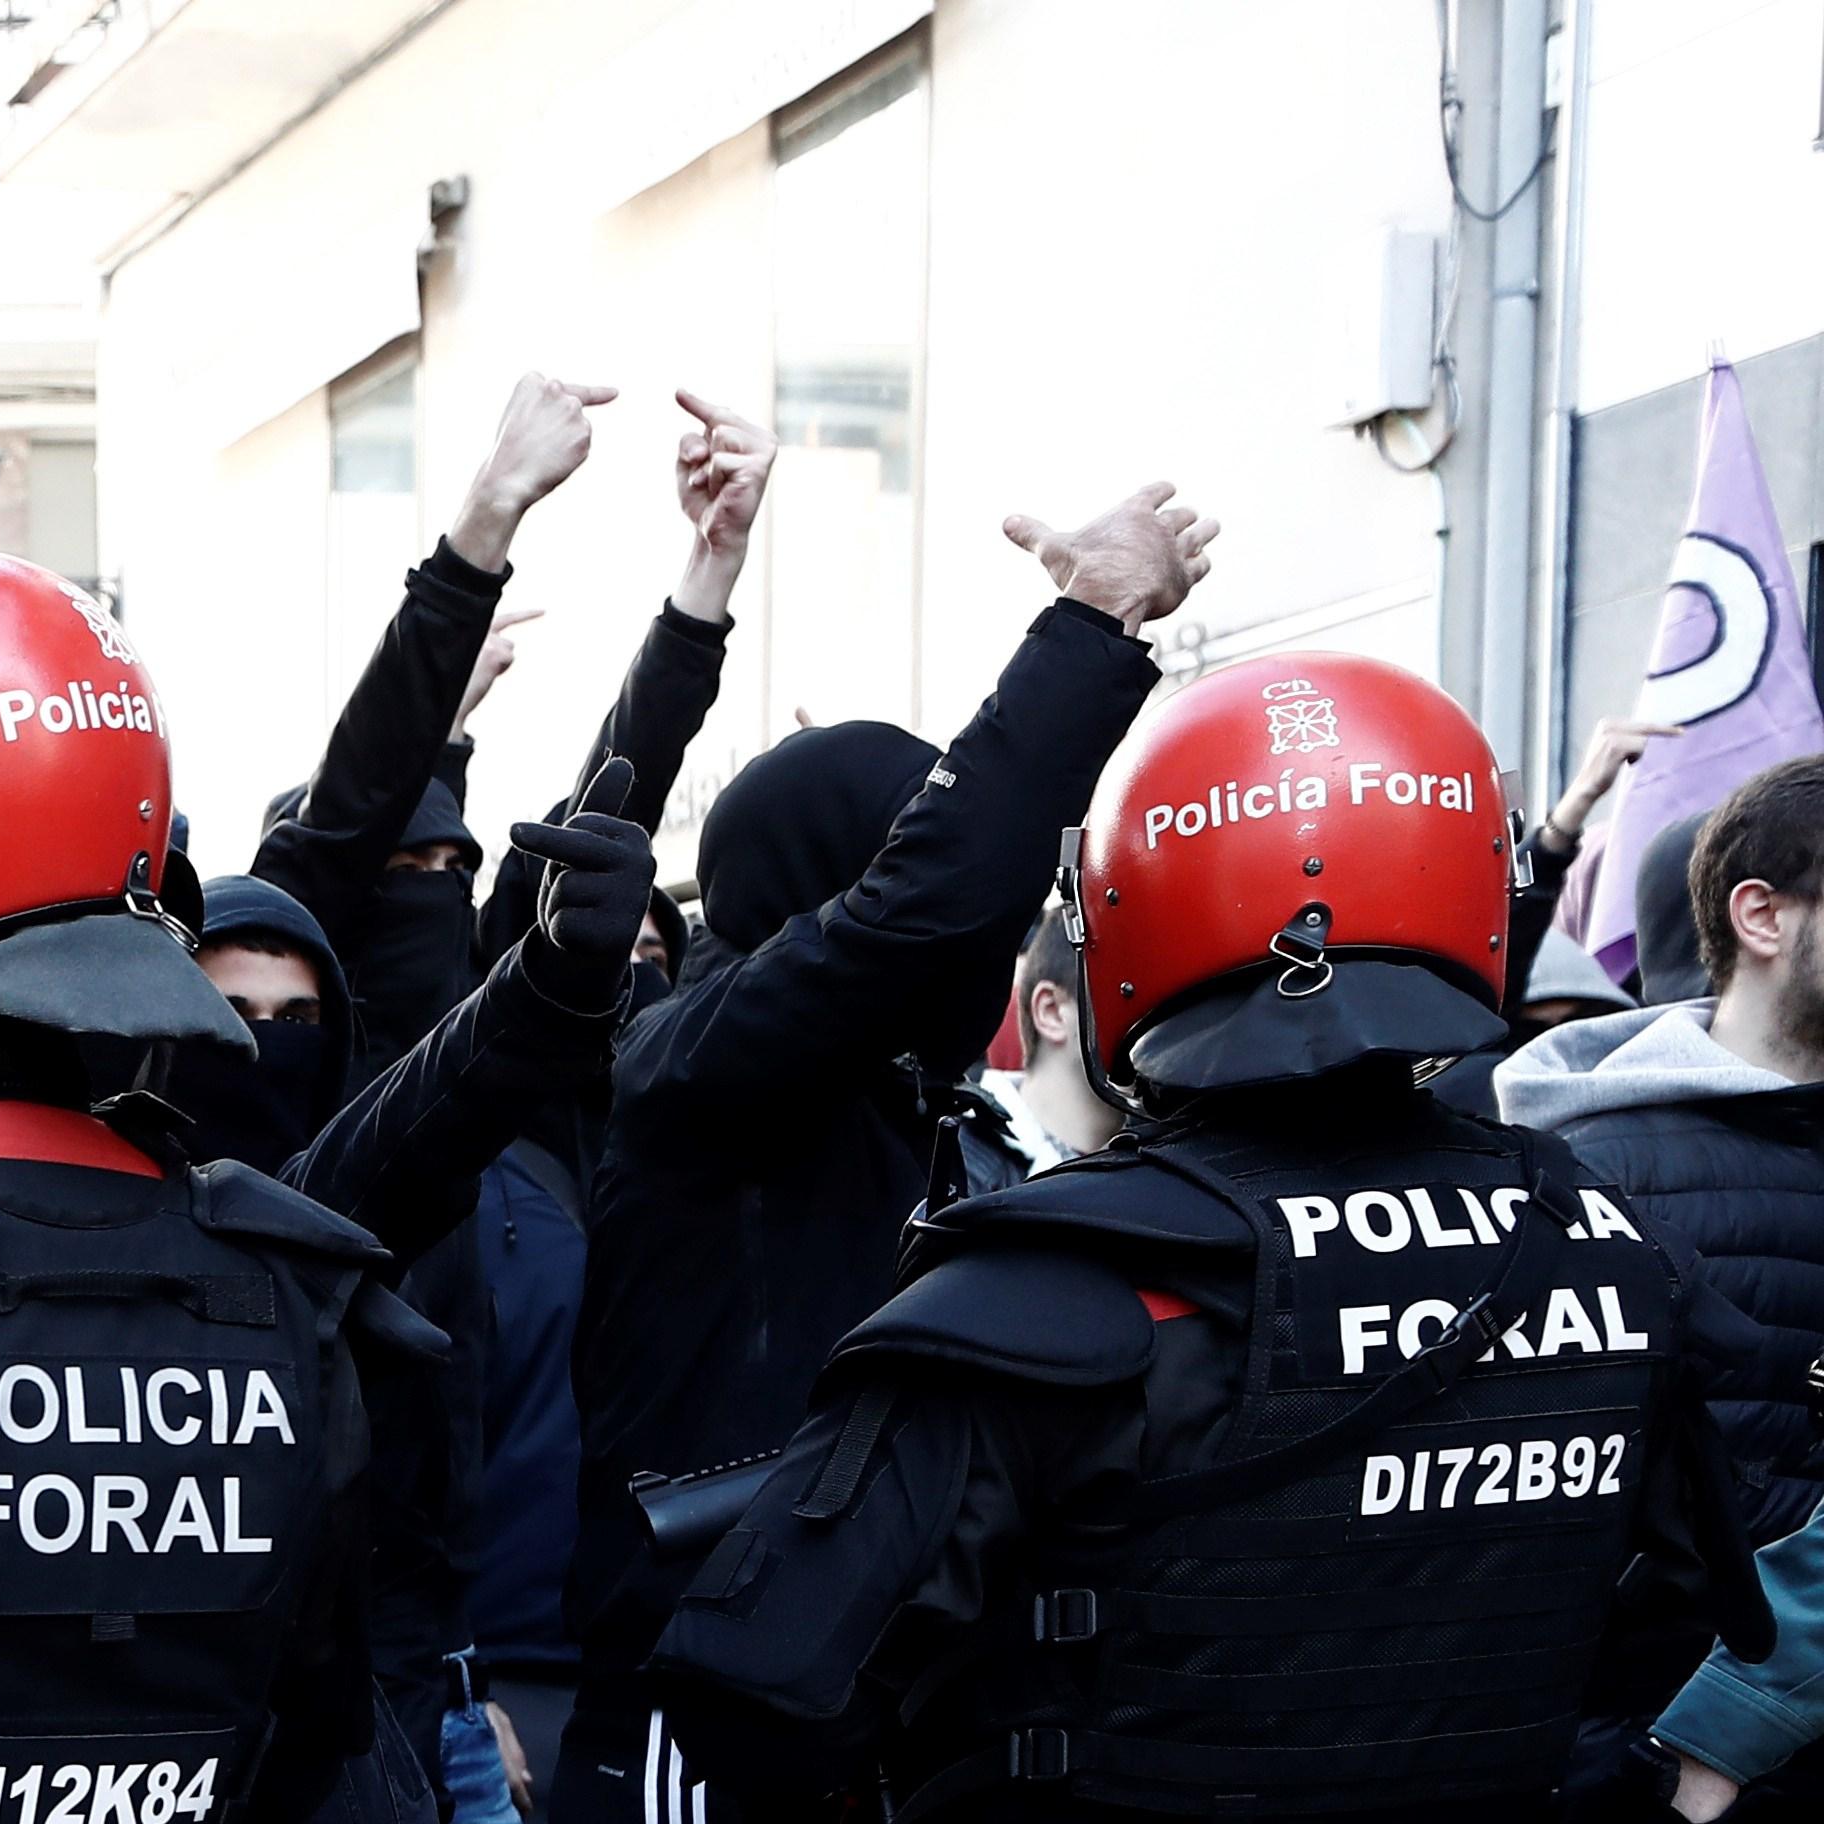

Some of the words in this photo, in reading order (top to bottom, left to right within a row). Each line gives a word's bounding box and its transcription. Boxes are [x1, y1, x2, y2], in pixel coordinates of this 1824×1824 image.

[1144, 768, 1328, 850] Policía
[1348, 762, 1474, 814] Foral
[1277, 1187, 1643, 1258] POLICA
[1361, 1433, 1626, 1516] DI72B92
